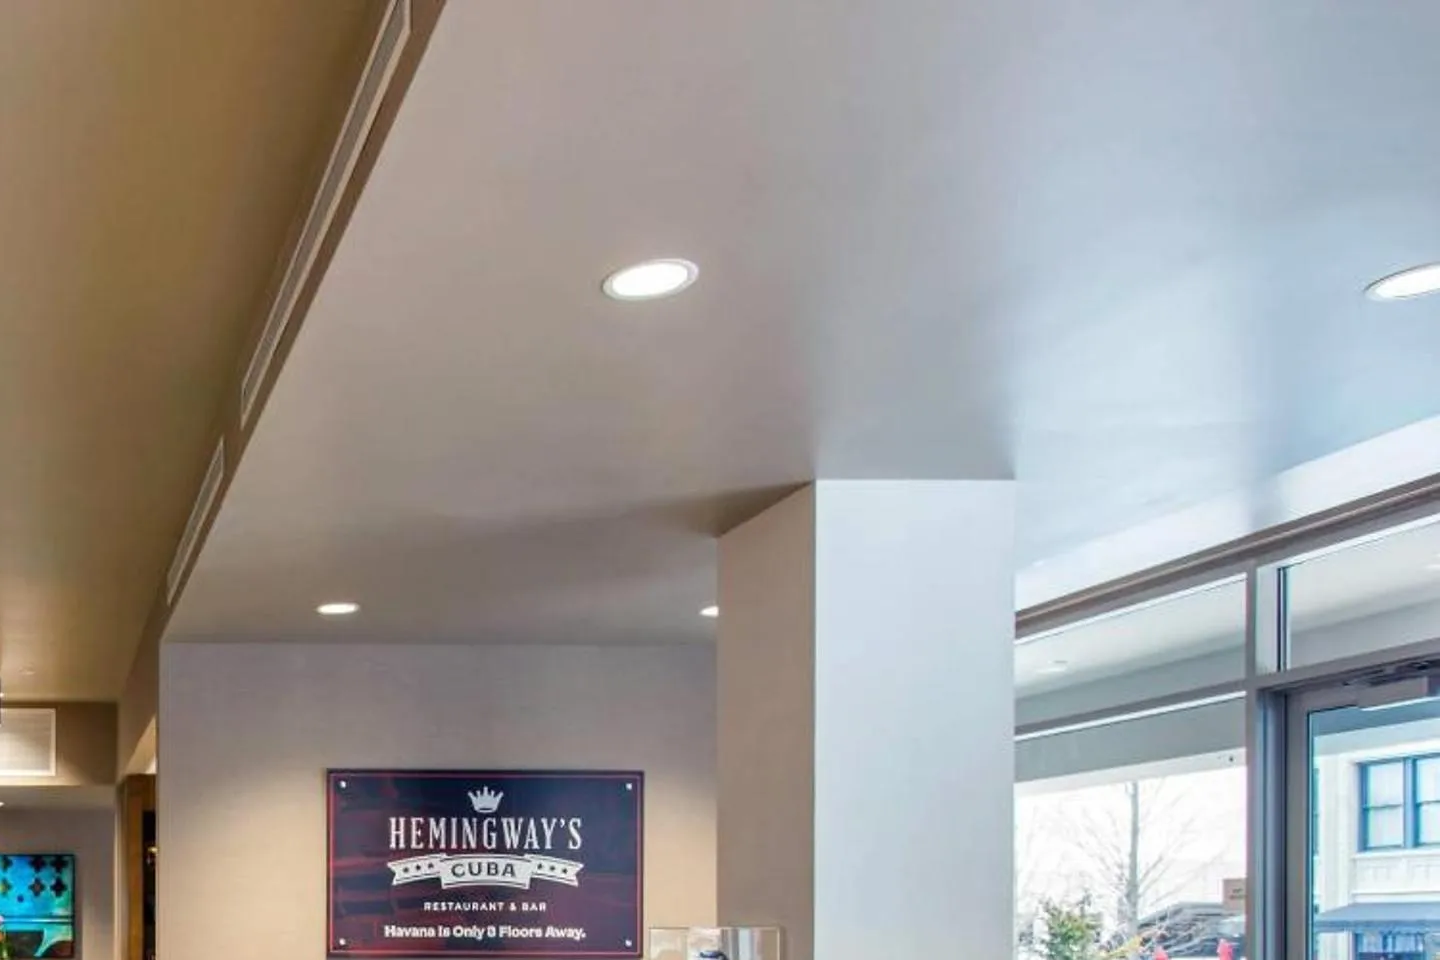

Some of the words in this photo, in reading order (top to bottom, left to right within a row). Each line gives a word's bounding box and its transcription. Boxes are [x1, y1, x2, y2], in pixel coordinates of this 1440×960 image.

[389, 817, 582, 850] HEMINGWAY'S
[450, 861, 516, 878] CUBA
[423, 902, 504, 911] RESTAURANT
[509, 902, 517, 911] &
[522, 902, 547, 911] BAR
[384, 925, 435, 938] Havana
[438, 925, 451, 938] Is
[452, 925, 485, 941] Only
[499, 925, 543, 938] Floors
[545, 925, 586, 941] Away.
